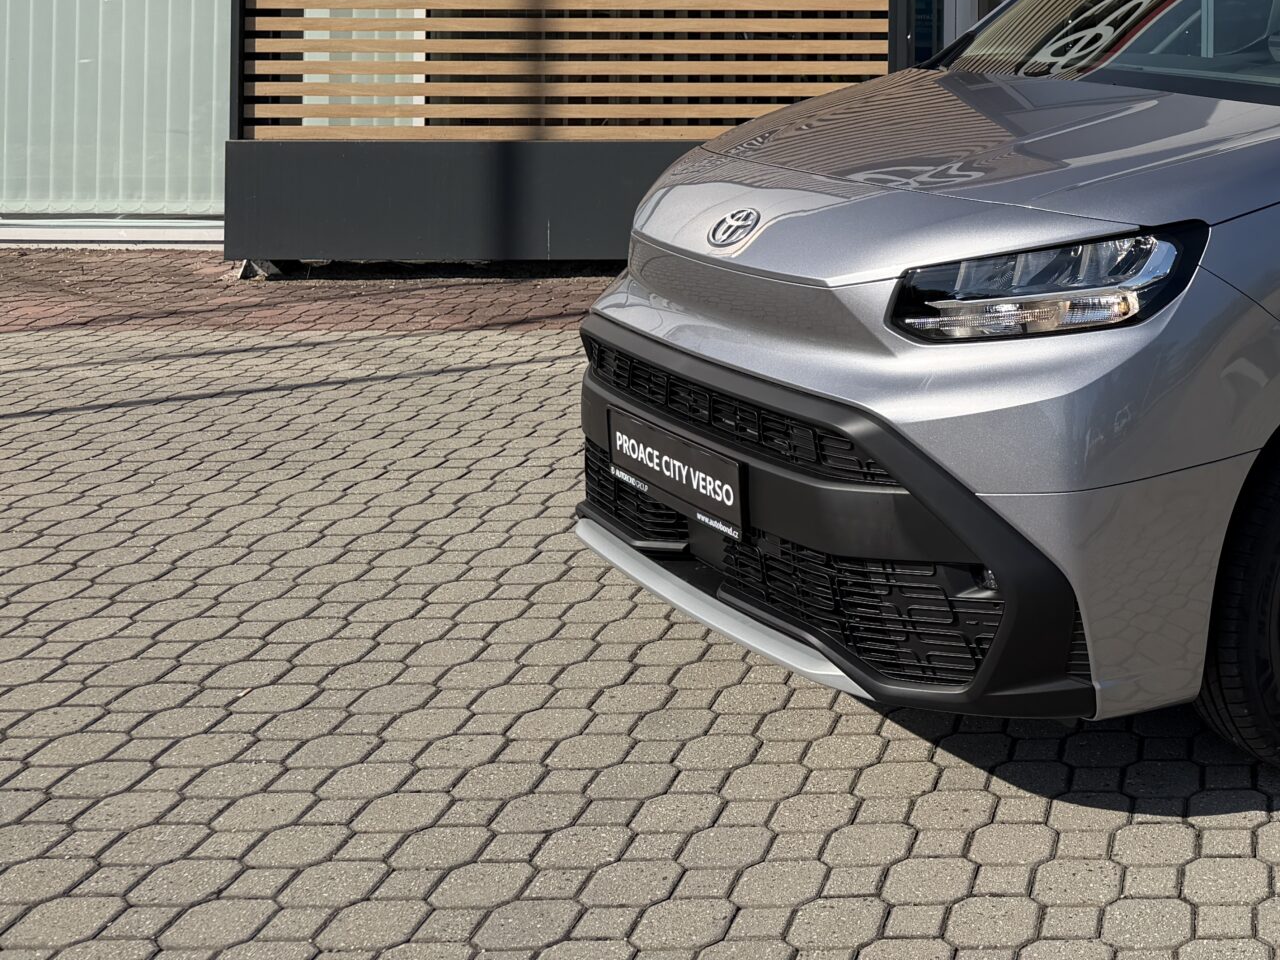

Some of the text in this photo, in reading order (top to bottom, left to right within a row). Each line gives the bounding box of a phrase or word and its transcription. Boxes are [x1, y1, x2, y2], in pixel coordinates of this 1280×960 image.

[615, 431, 734, 507] PROACE CITY VERSO
[696, 511, 740, 539] www.autobond.cz
